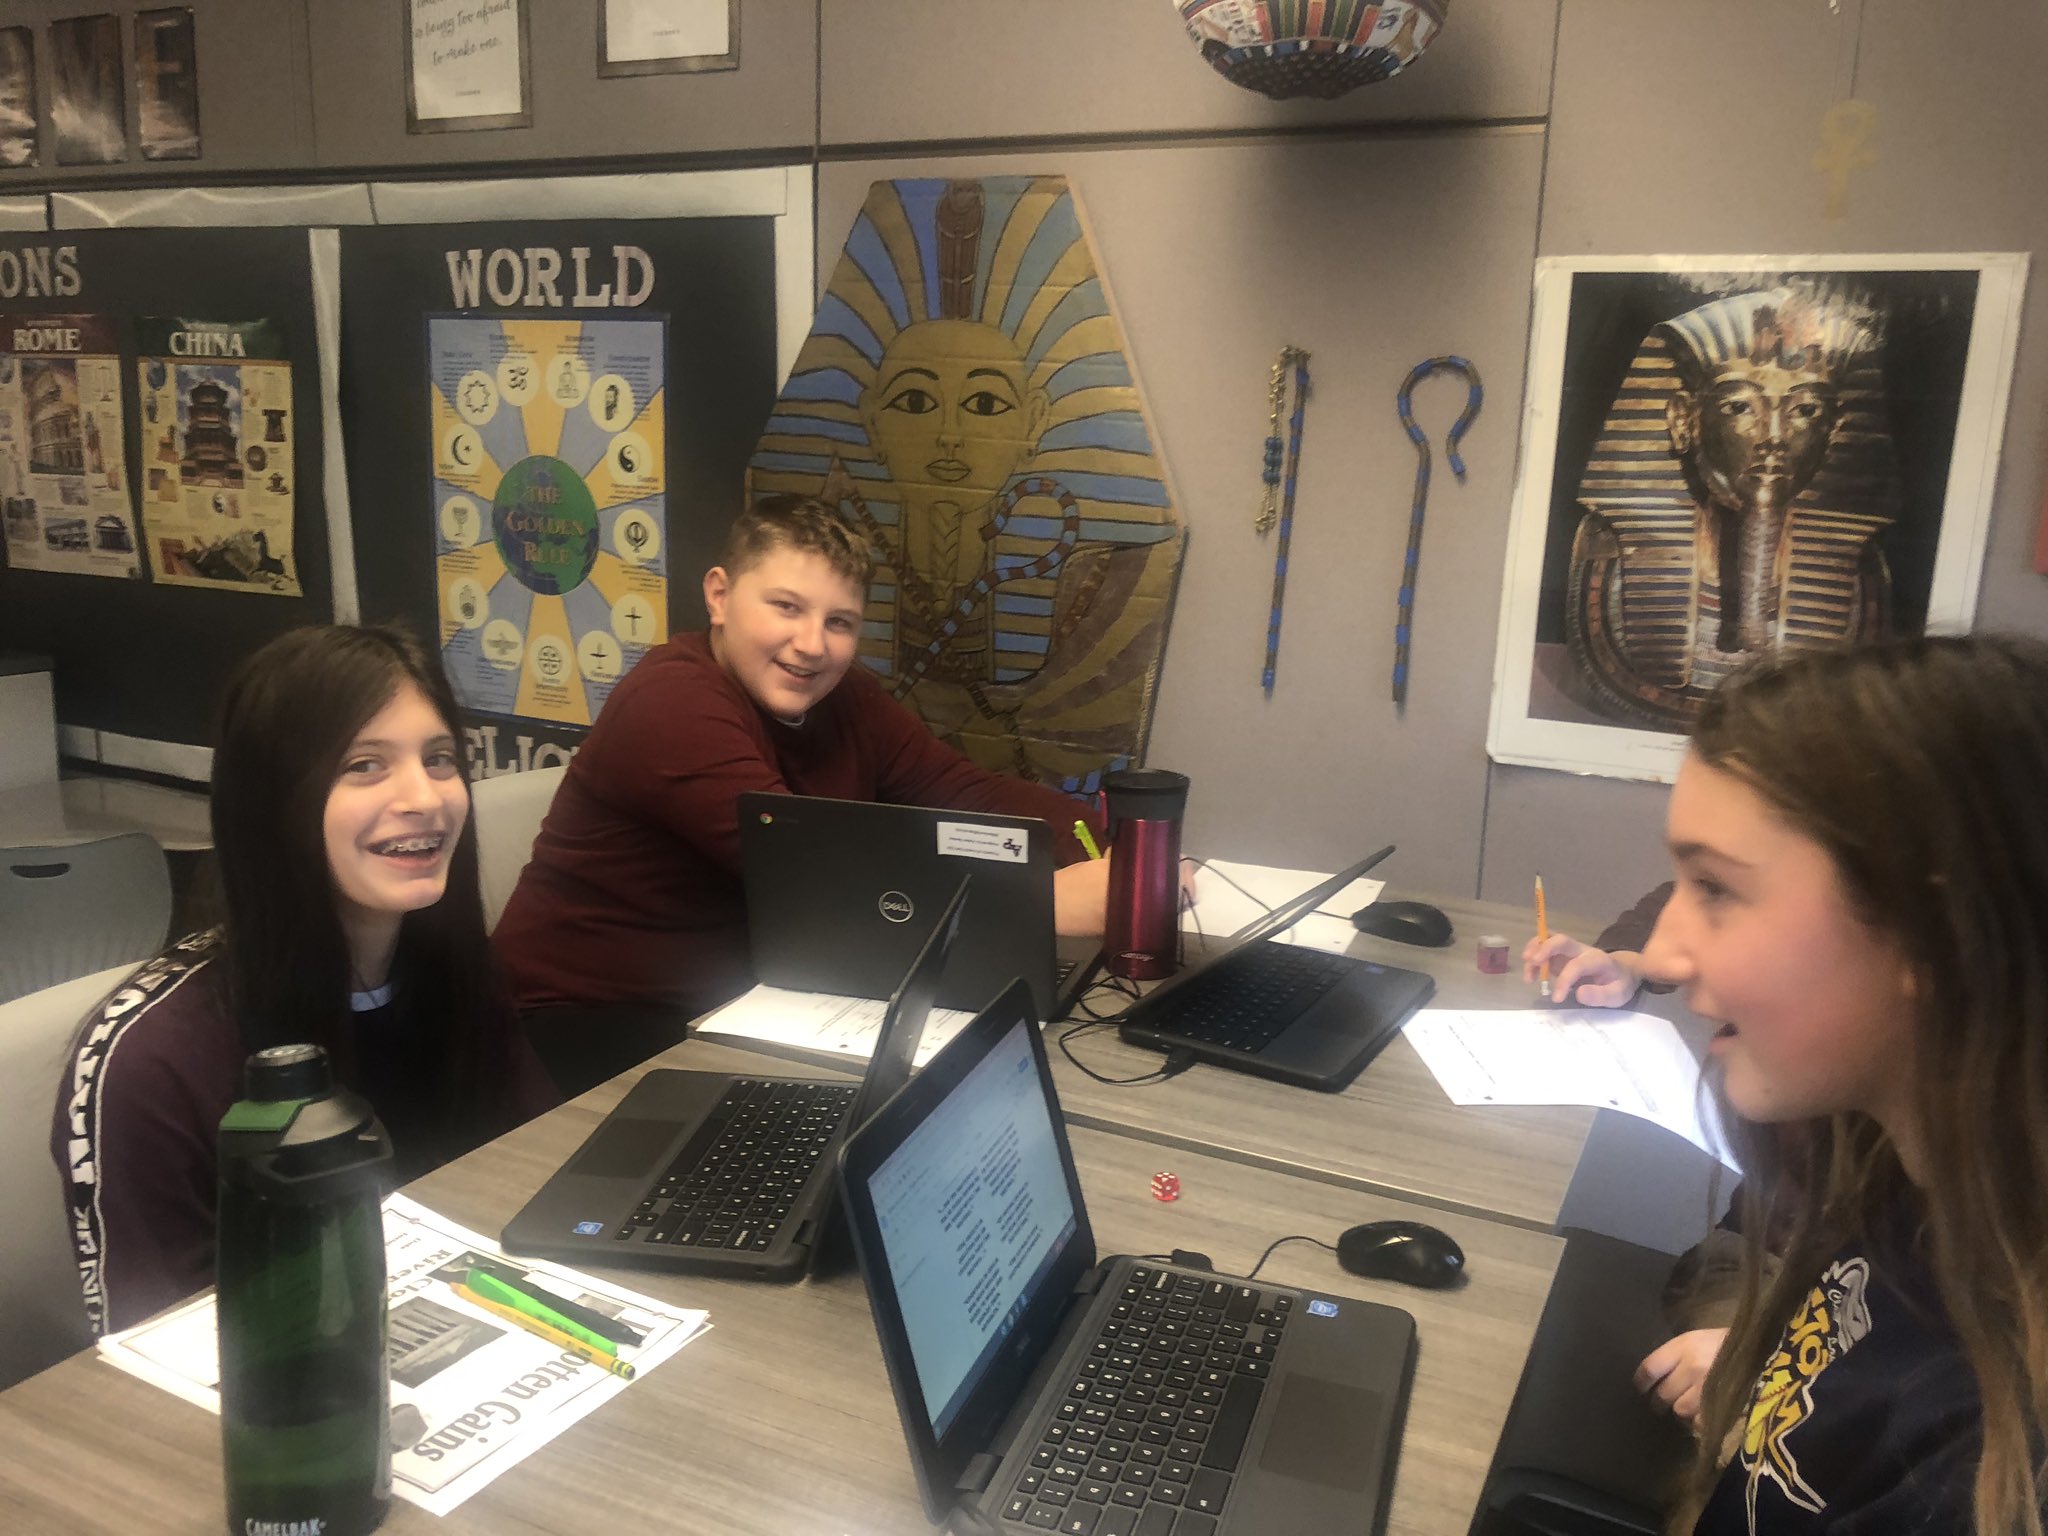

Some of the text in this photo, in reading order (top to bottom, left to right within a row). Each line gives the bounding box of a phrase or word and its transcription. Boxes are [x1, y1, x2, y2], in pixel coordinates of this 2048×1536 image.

[445, 245, 656, 309] WORLD
[13, 328, 82, 352] ROME
[168, 331, 247, 357] CHINA
[883, 900, 912, 912] DELL
[412, 1401, 522, 1462] Gains
